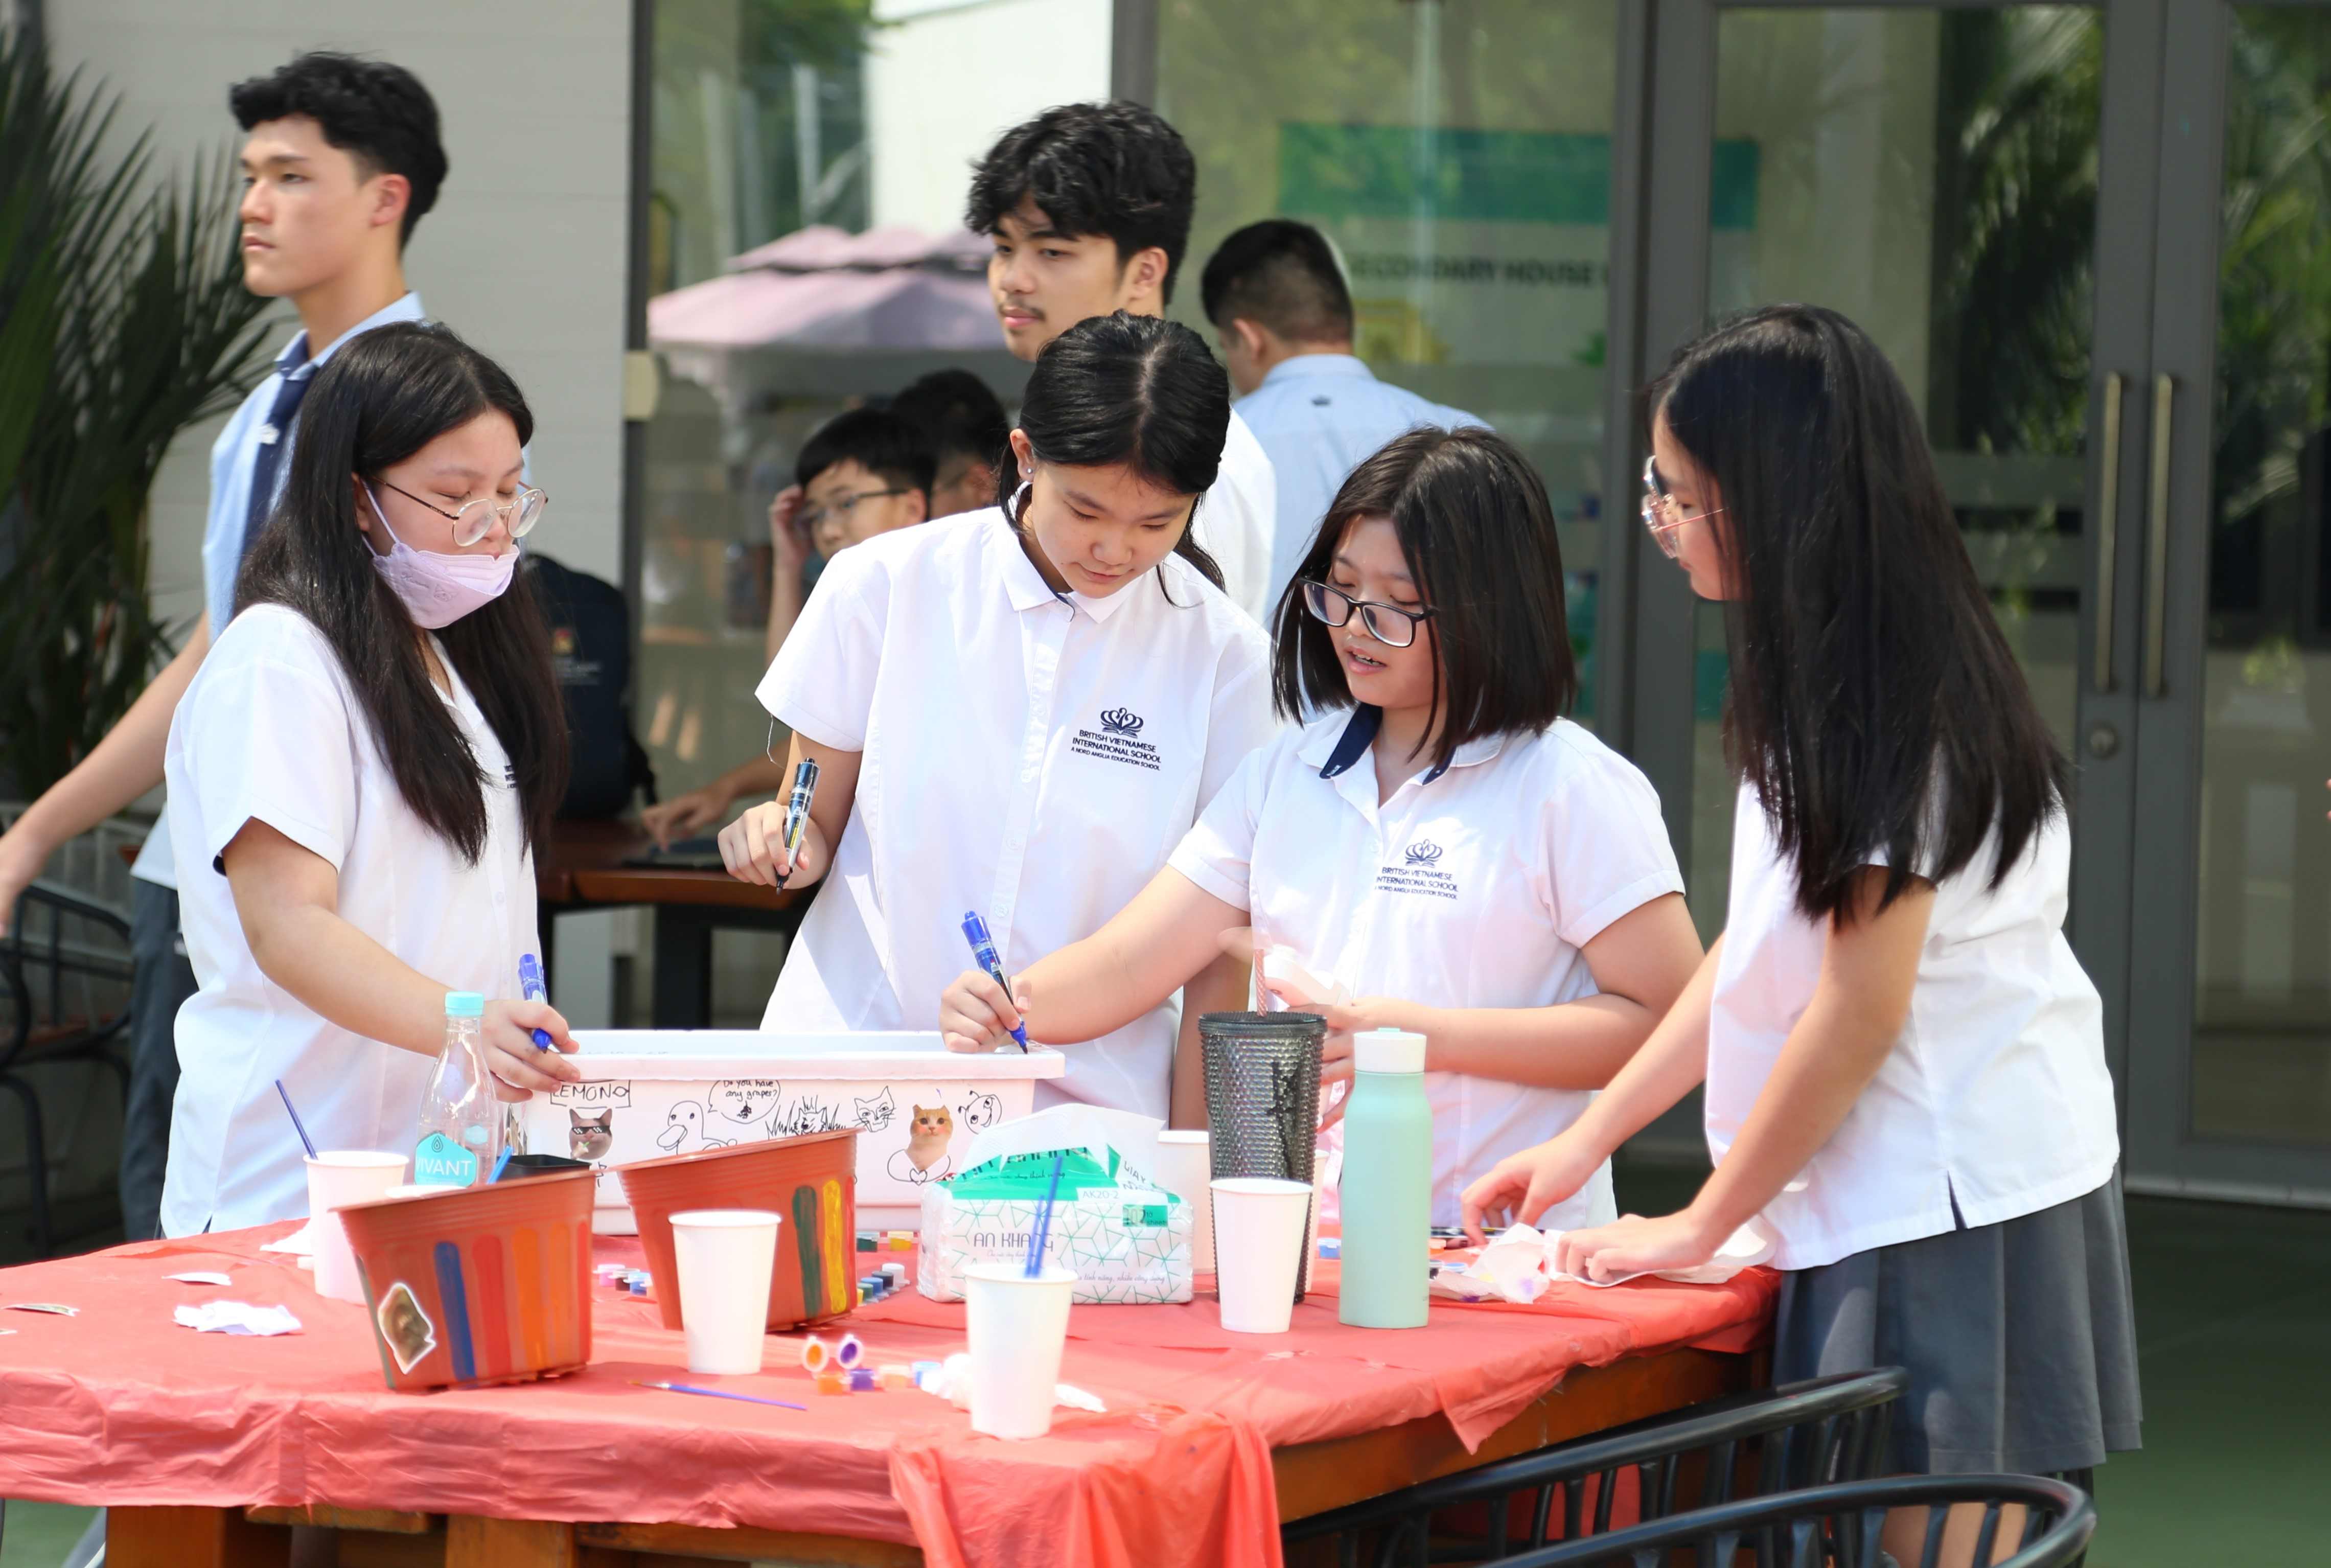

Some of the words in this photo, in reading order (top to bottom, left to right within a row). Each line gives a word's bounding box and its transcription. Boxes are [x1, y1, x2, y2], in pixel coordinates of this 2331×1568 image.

[1079, 729, 1107, 743] BRITISH
[1109, 737, 1156, 753] VIETNAMESE
[1072, 737, 1129, 757] INTERNATIONAL
[1130, 750, 1161, 763] SCHOOL
[1091, 751, 1110, 760] ANGLIA
[1111, 755, 1140, 766] EDUCATION
[1141, 761, 1161, 771] SCHOOL
[1382, 867, 1410, 877] BRITISH
[1411, 870, 1452, 881] VIETNAMESE
[1428, 881, 1459, 892] SCHOOL
[1437, 891, 1458, 900] SCHOOL
[736, 1080, 752, 1089] you
[755, 1079, 773, 1088] have
[726, 1091, 743, 1102] any
[747, 1089, 777, 1100] grapes?
[1082, 1189, 1119, 1199] AK20-2
[974, 1232, 996, 1248] AN
[1001, 1232, 1053, 1253] KHAG
